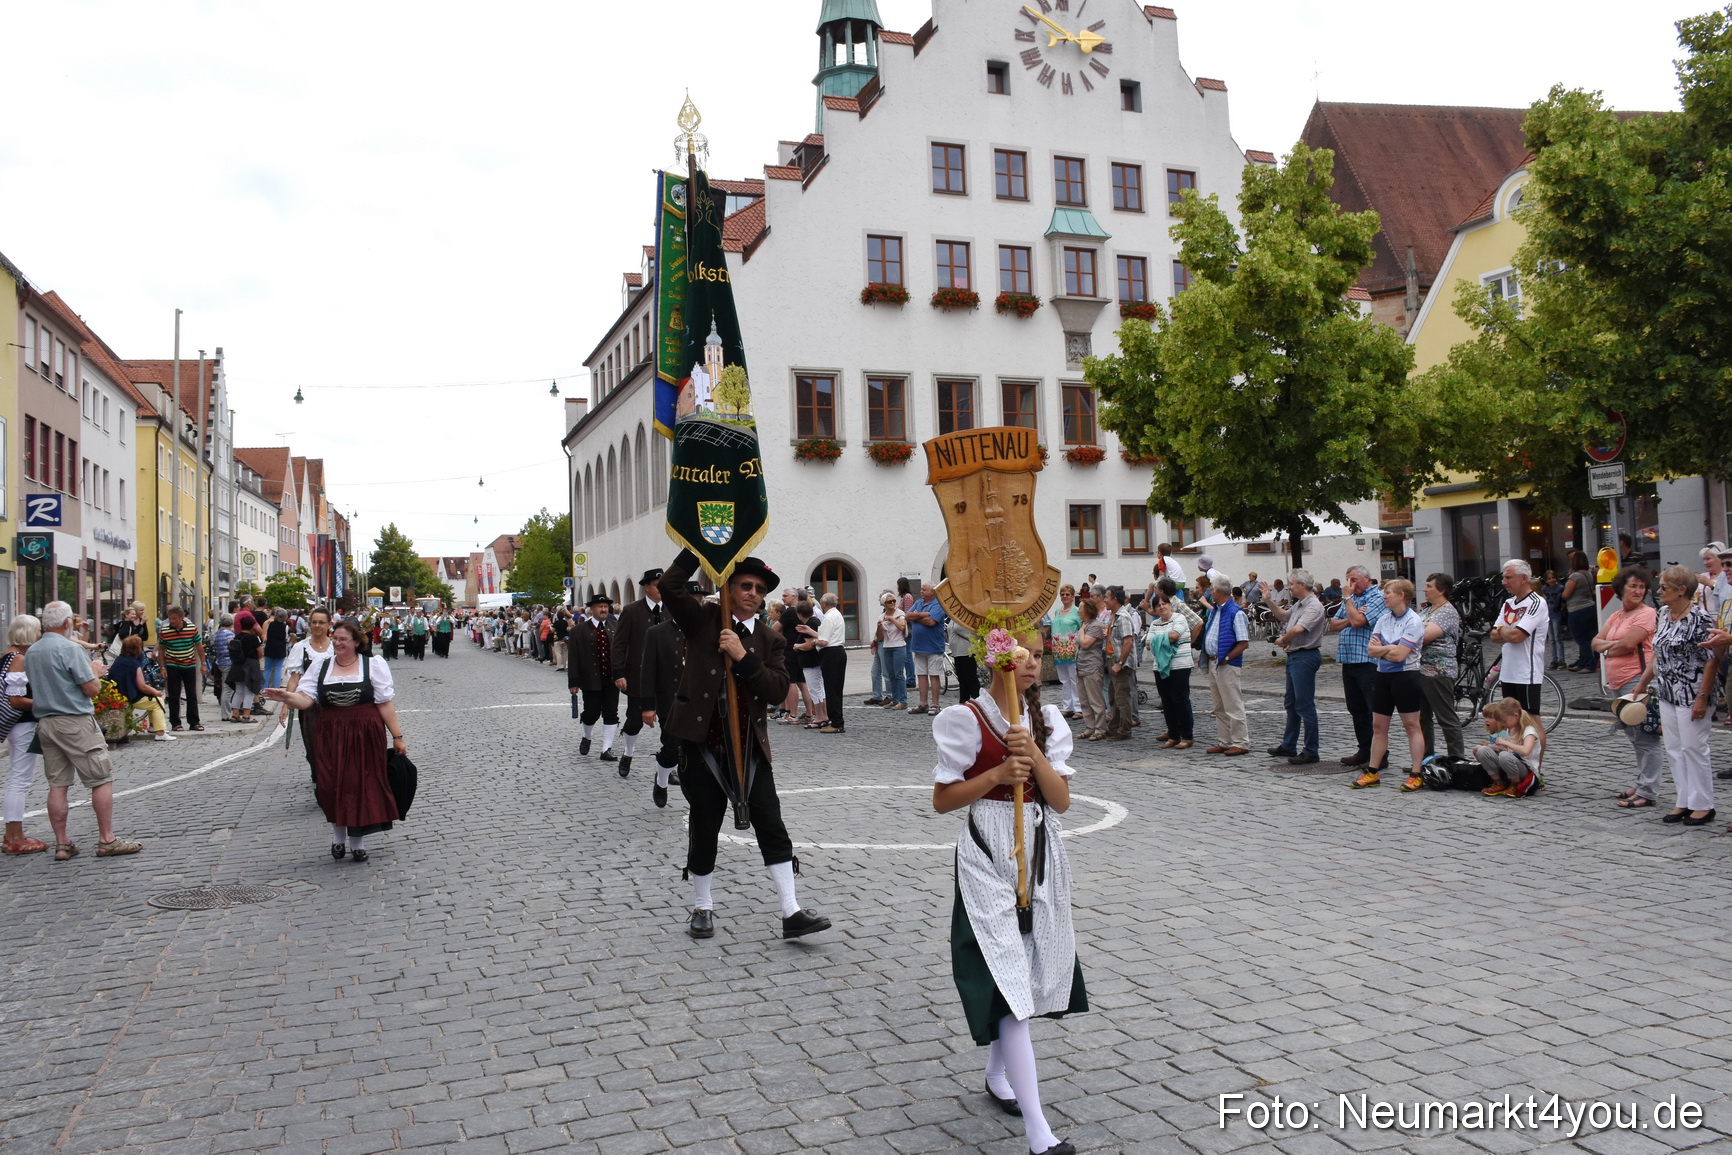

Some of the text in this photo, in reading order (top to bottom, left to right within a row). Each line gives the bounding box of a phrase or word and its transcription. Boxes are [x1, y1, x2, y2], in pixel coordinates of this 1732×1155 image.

[934, 432, 1029, 469] NITTENAU
[1592, 469, 1622, 480] Wendebereich
[954, 493, 1029, 515] 19 78
[28, 541, 41, 555] G2
